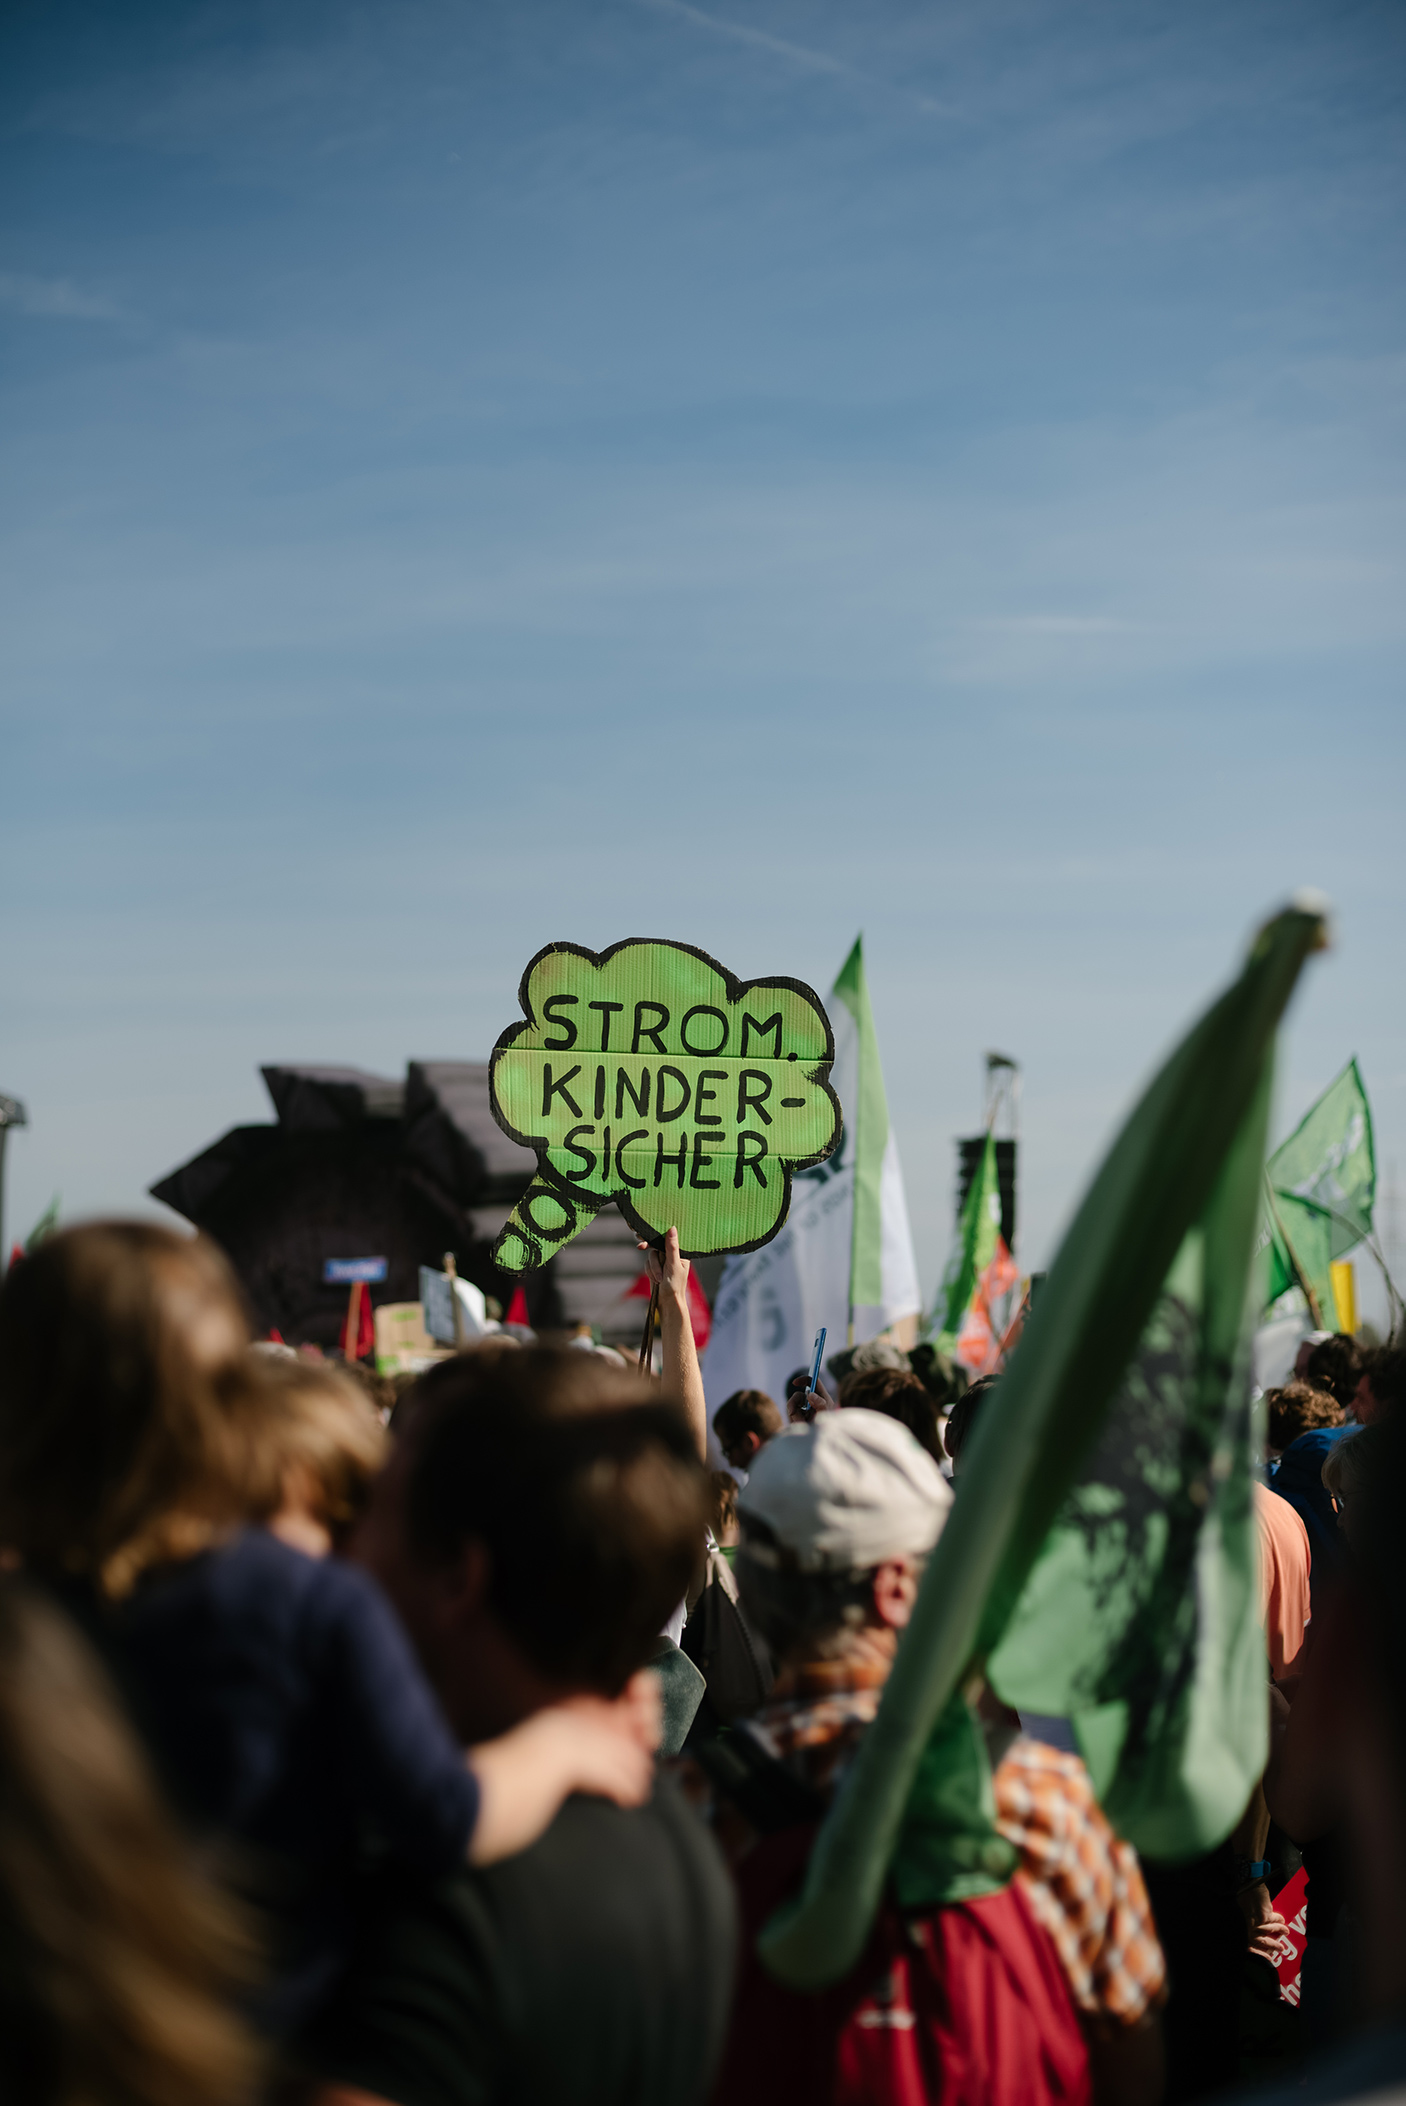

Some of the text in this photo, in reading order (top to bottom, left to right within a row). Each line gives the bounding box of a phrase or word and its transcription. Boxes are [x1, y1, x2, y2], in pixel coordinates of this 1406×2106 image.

[542, 994, 798, 1061] STROM.
[541, 1062, 806, 1126] KINDER-
[563, 1125, 768, 1189] SICHER
